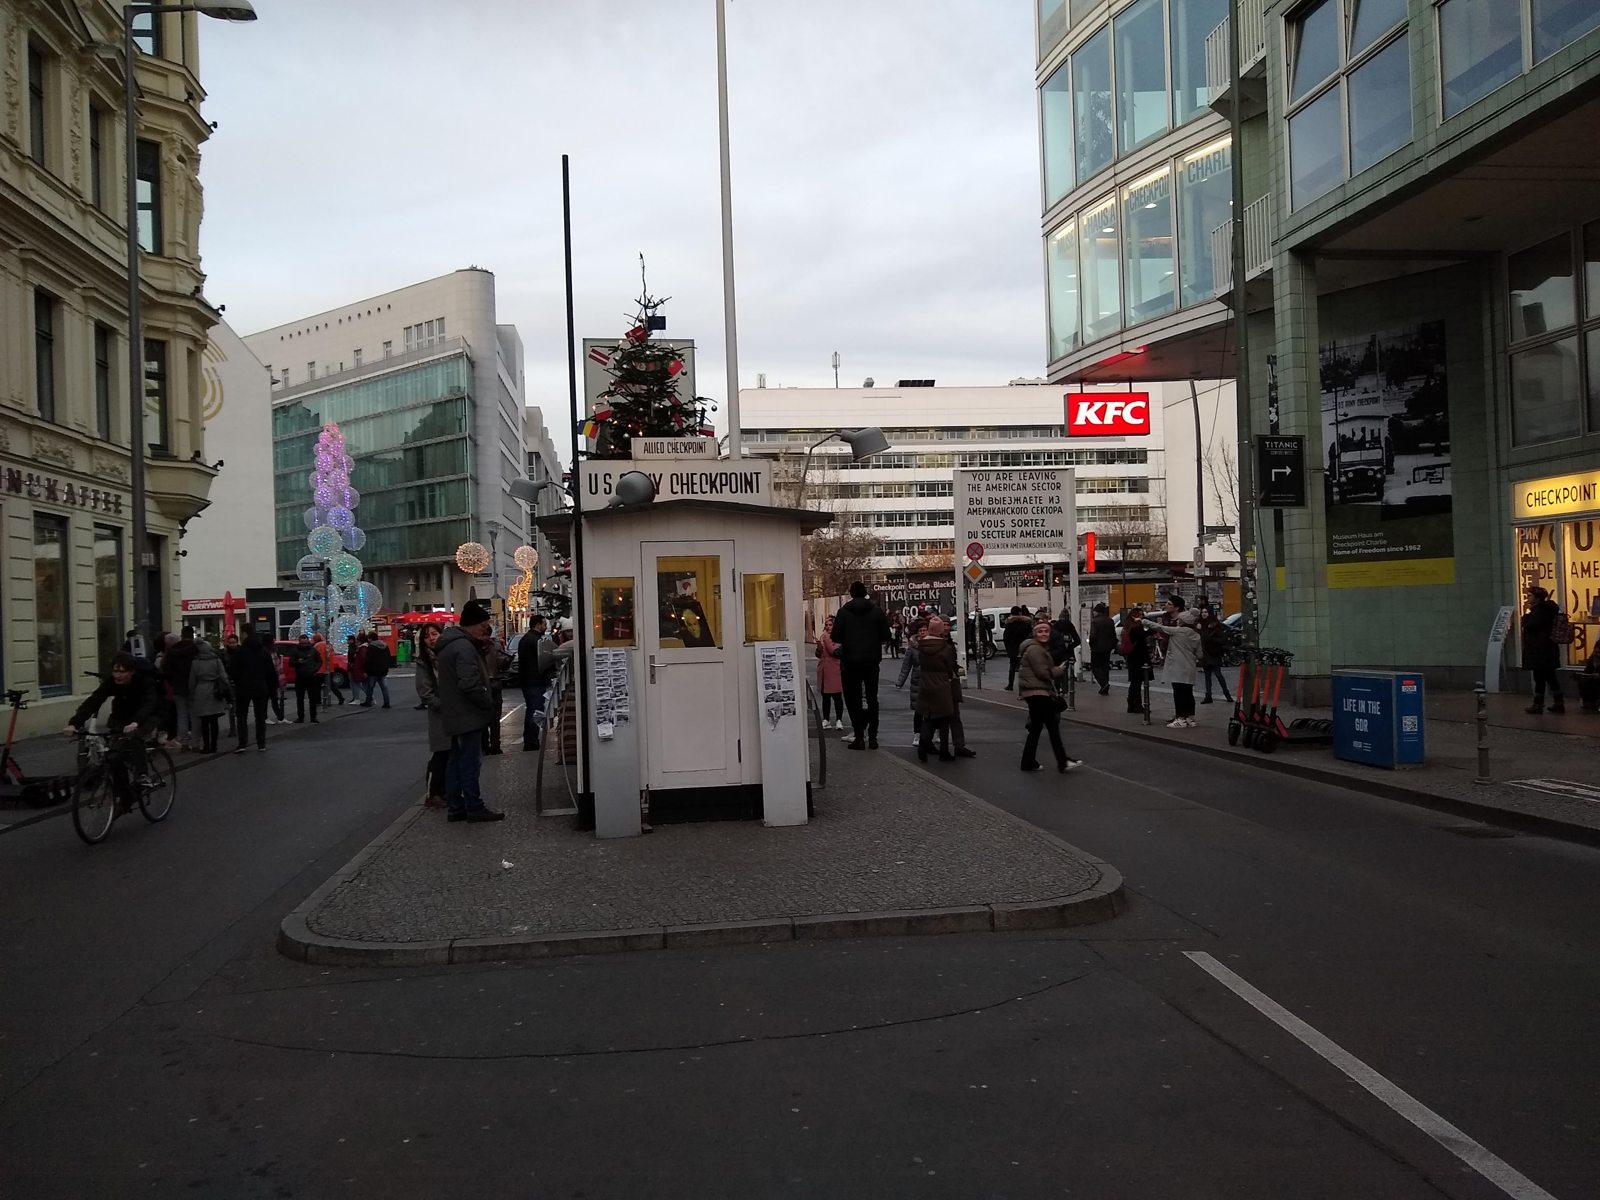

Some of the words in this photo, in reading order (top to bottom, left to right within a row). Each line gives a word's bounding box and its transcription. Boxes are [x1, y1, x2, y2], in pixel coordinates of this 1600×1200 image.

[1073, 401, 1147, 425] KFC
[644, 441, 665, 454] ALLIED
[667, 441, 707, 454] CHECKPOINT
[1265, 441, 1298, 449] TITANIC
[972, 472, 990, 481] YOU
[996, 472, 1013, 481] ARE
[1019, 471, 1057, 480] LEAVING
[670, 472, 762, 495] CHECKPOINT
[968, 483, 981, 491] THE
[985, 482, 1027, 491] AMERICAN
[1032, 482, 1062, 491] SECTOR
[46, 477, 122, 515] KAFFEE
[969, 497, 983, 506] ВЫ
[988, 496, 1044, 506] ВЫЕЗЖАЕТЕ
[1049, 495, 1061, 504] ИЗ
[1526, 483, 1598, 508] CHECKPOINT
[967, 507, 1029, 516] АМЕРИКАНСКОГО
[1031, 506, 1064, 515] СЕКТОРА
[980, 519, 1006, 528] VOUS
[1011, 518, 1046, 528] SORTEZ
[968, 530, 979, 539] DU
[981, 530, 1017, 539] SECTEUR
[874, 584, 906, 592] Checkpoin
[1343, 698, 1357, 712] LIFE
[1358, 699, 1366, 714] IN
[1367, 700, 1381, 715] THE
[1355, 718, 1368, 732] GDR
